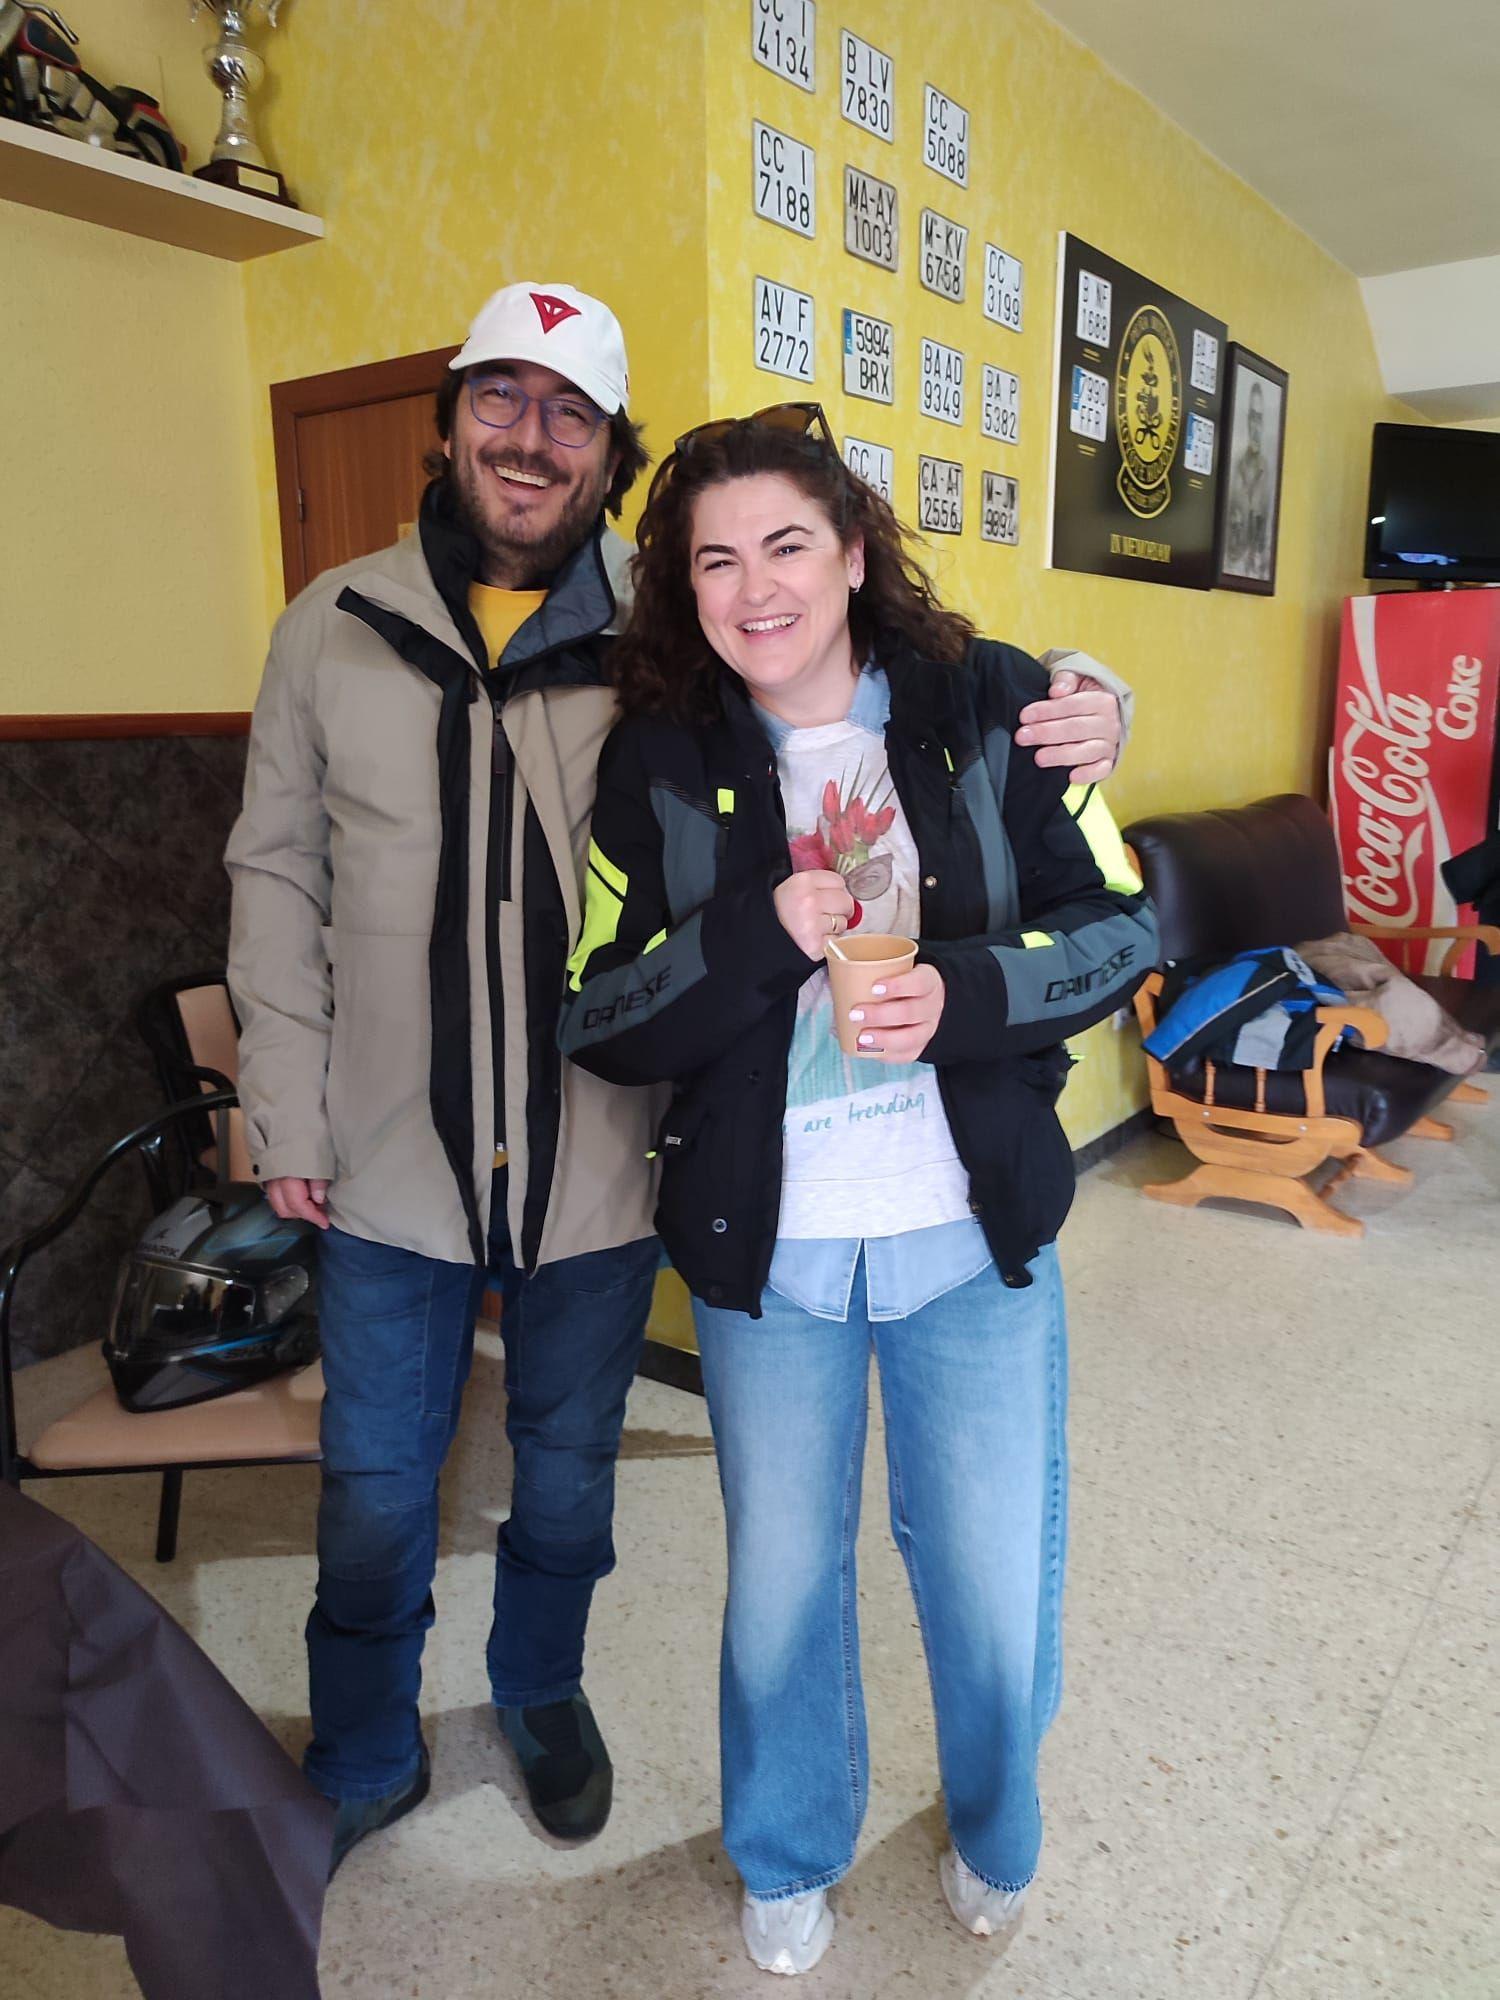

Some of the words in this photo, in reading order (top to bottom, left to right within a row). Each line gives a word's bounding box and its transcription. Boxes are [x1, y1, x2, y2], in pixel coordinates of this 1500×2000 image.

[758, 21, 809, 83] 4134
[846, 37, 857, 75] B
[868, 50, 889, 94] LV
[845, 79, 889, 133] 7830
[929, 92, 948, 131] CC
[956, 114, 966, 143] J
[760, 129, 785, 174] CC
[801, 149, 806, 186] I
[927, 129, 965, 181] 5088
[759, 172, 810, 228] 7188
[849, 180, 896, 226] MA-AY
[853, 214, 893, 262] 1003
[926, 252, 960, 295] 6758
[988, 250, 1005, 284] CC
[1014, 266, 1022, 292] J
[760, 285, 785, 326] AV
[798, 298, 809, 333] F
[987, 284, 1020, 326] 3199
[759, 327, 810, 376] 2772
[855, 319, 890, 359] 5994
[860, 357, 890, 396] BRX
[924, 344, 942, 378] BA
[945, 353, 963, 386] AD
[986, 370, 1002, 402] BA
[1009, 378, 1018, 404] P
[924, 380, 961, 419] 9349
[984, 403, 1017, 439] 5382
[849, 445, 869, 479] CC
[880, 452, 888, 485] L
[924, 496, 959, 529] 2556
[1436, 654, 1482, 741] Coke
[803, 1115, 832, 1133] are
[848, 1092, 925, 1124] trending
